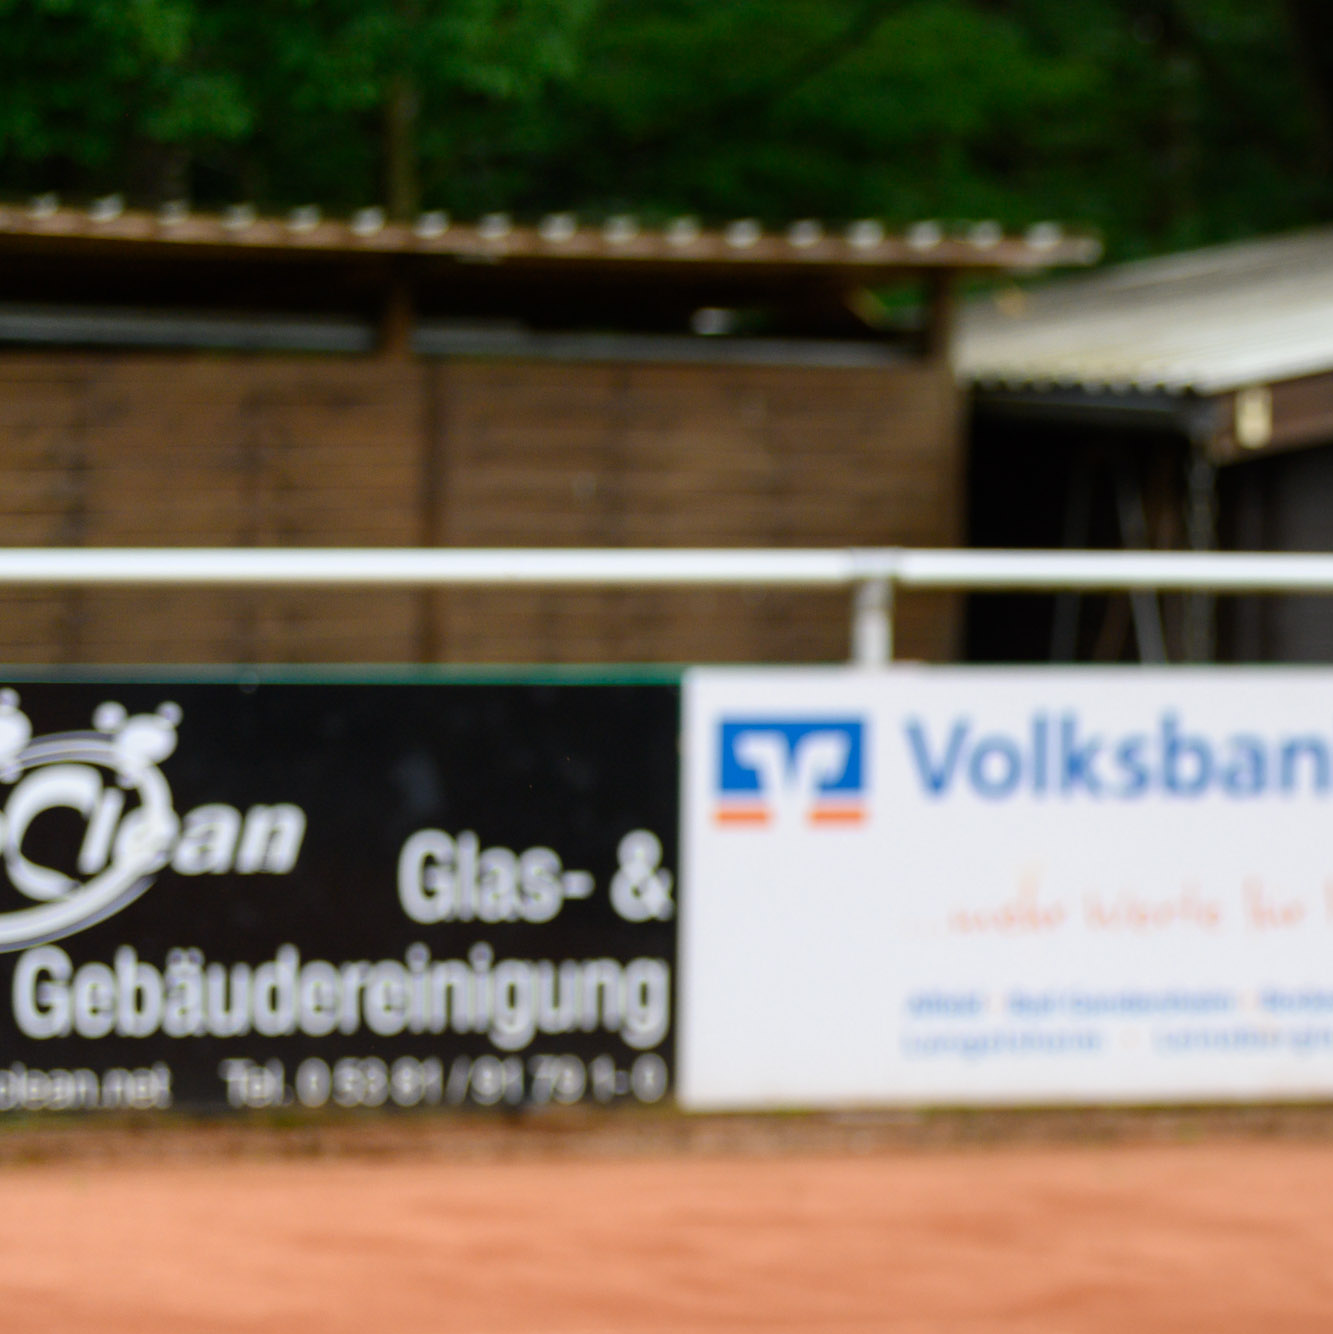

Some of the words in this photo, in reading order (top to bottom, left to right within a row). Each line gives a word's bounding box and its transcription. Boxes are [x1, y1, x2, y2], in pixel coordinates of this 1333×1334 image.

[399, 829, 593, 923] Glas-
[611, 829, 673, 922] &
[12, 943, 671, 1050] Gebäudereinigung
[297, 1058, 331, 1107] 0
